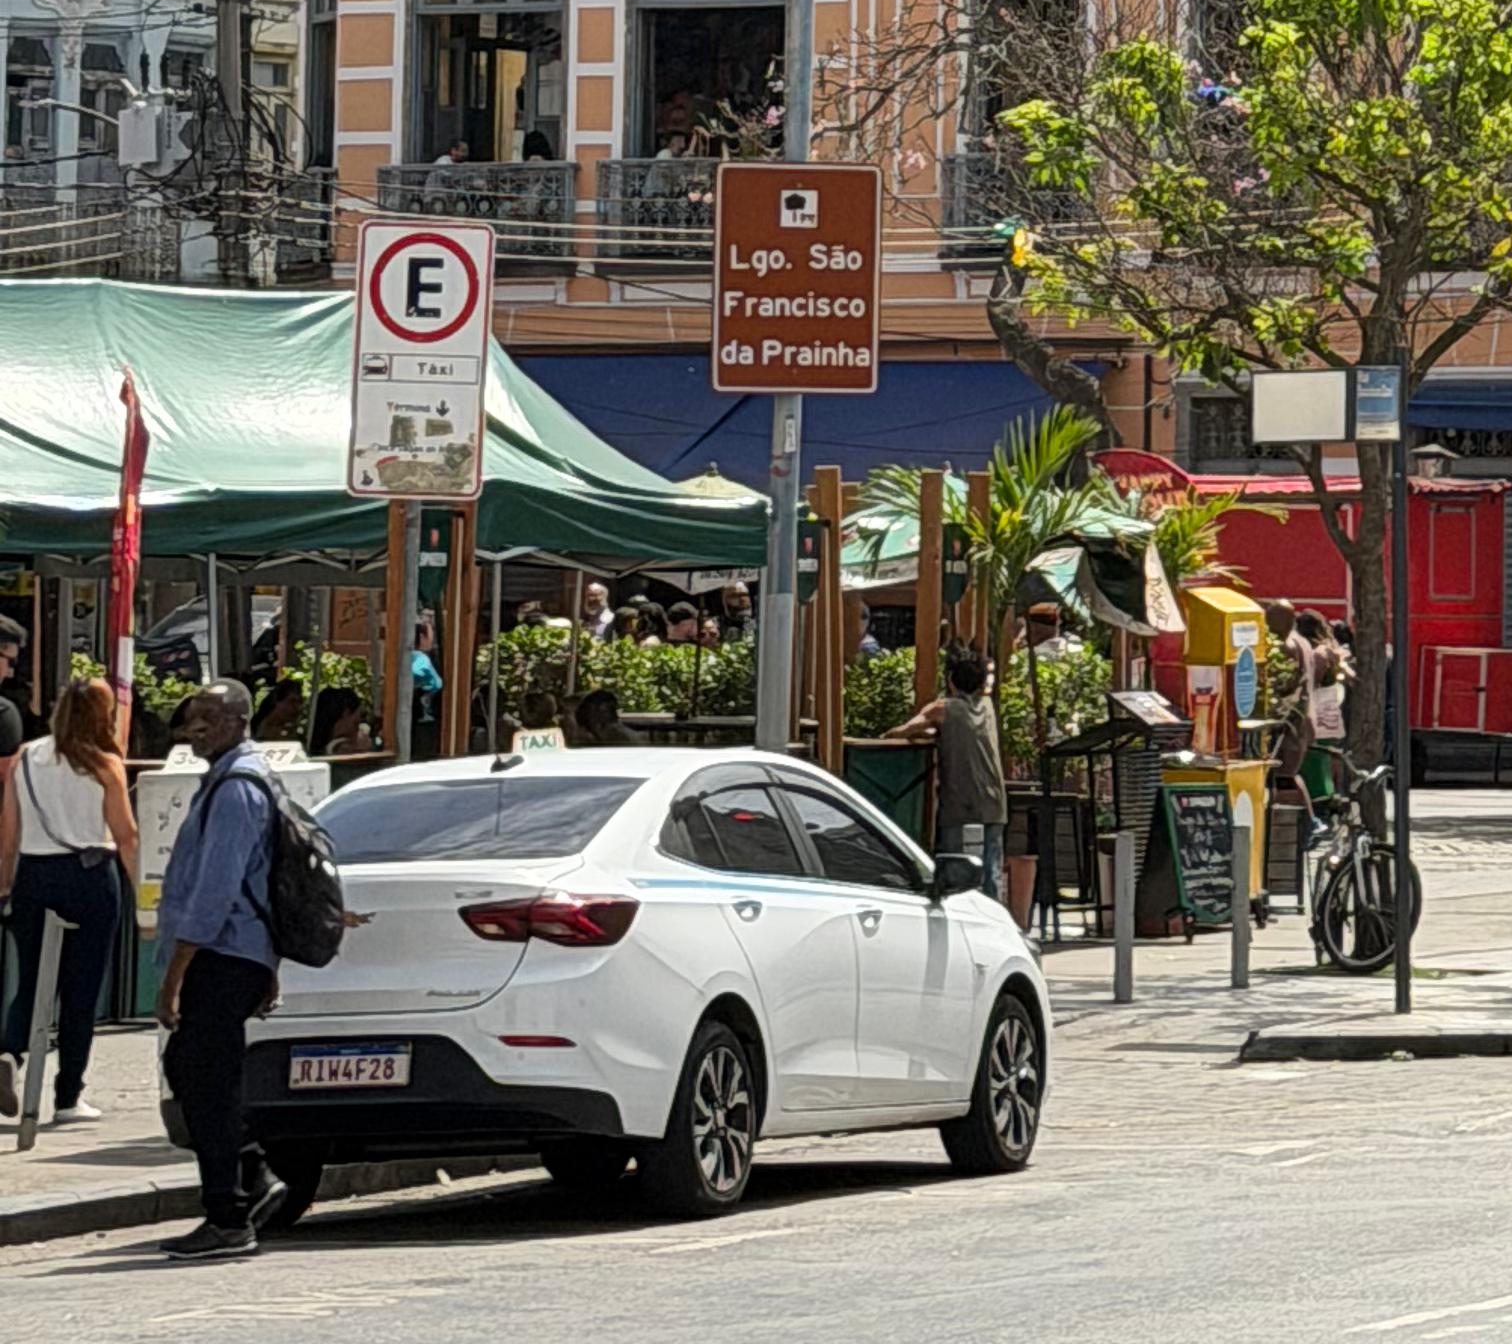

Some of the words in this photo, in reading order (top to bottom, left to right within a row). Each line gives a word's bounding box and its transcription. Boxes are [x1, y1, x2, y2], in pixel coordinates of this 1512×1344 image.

[729, 243, 793, 278] Lgo.
[808, 242, 863, 272] São
[404, 256, 444, 319] E
[722, 290, 867, 319] Francisco
[720, 339, 755, 366] da
[761, 339, 871, 368] Prainha
[519, 734, 557, 751] TAXI
